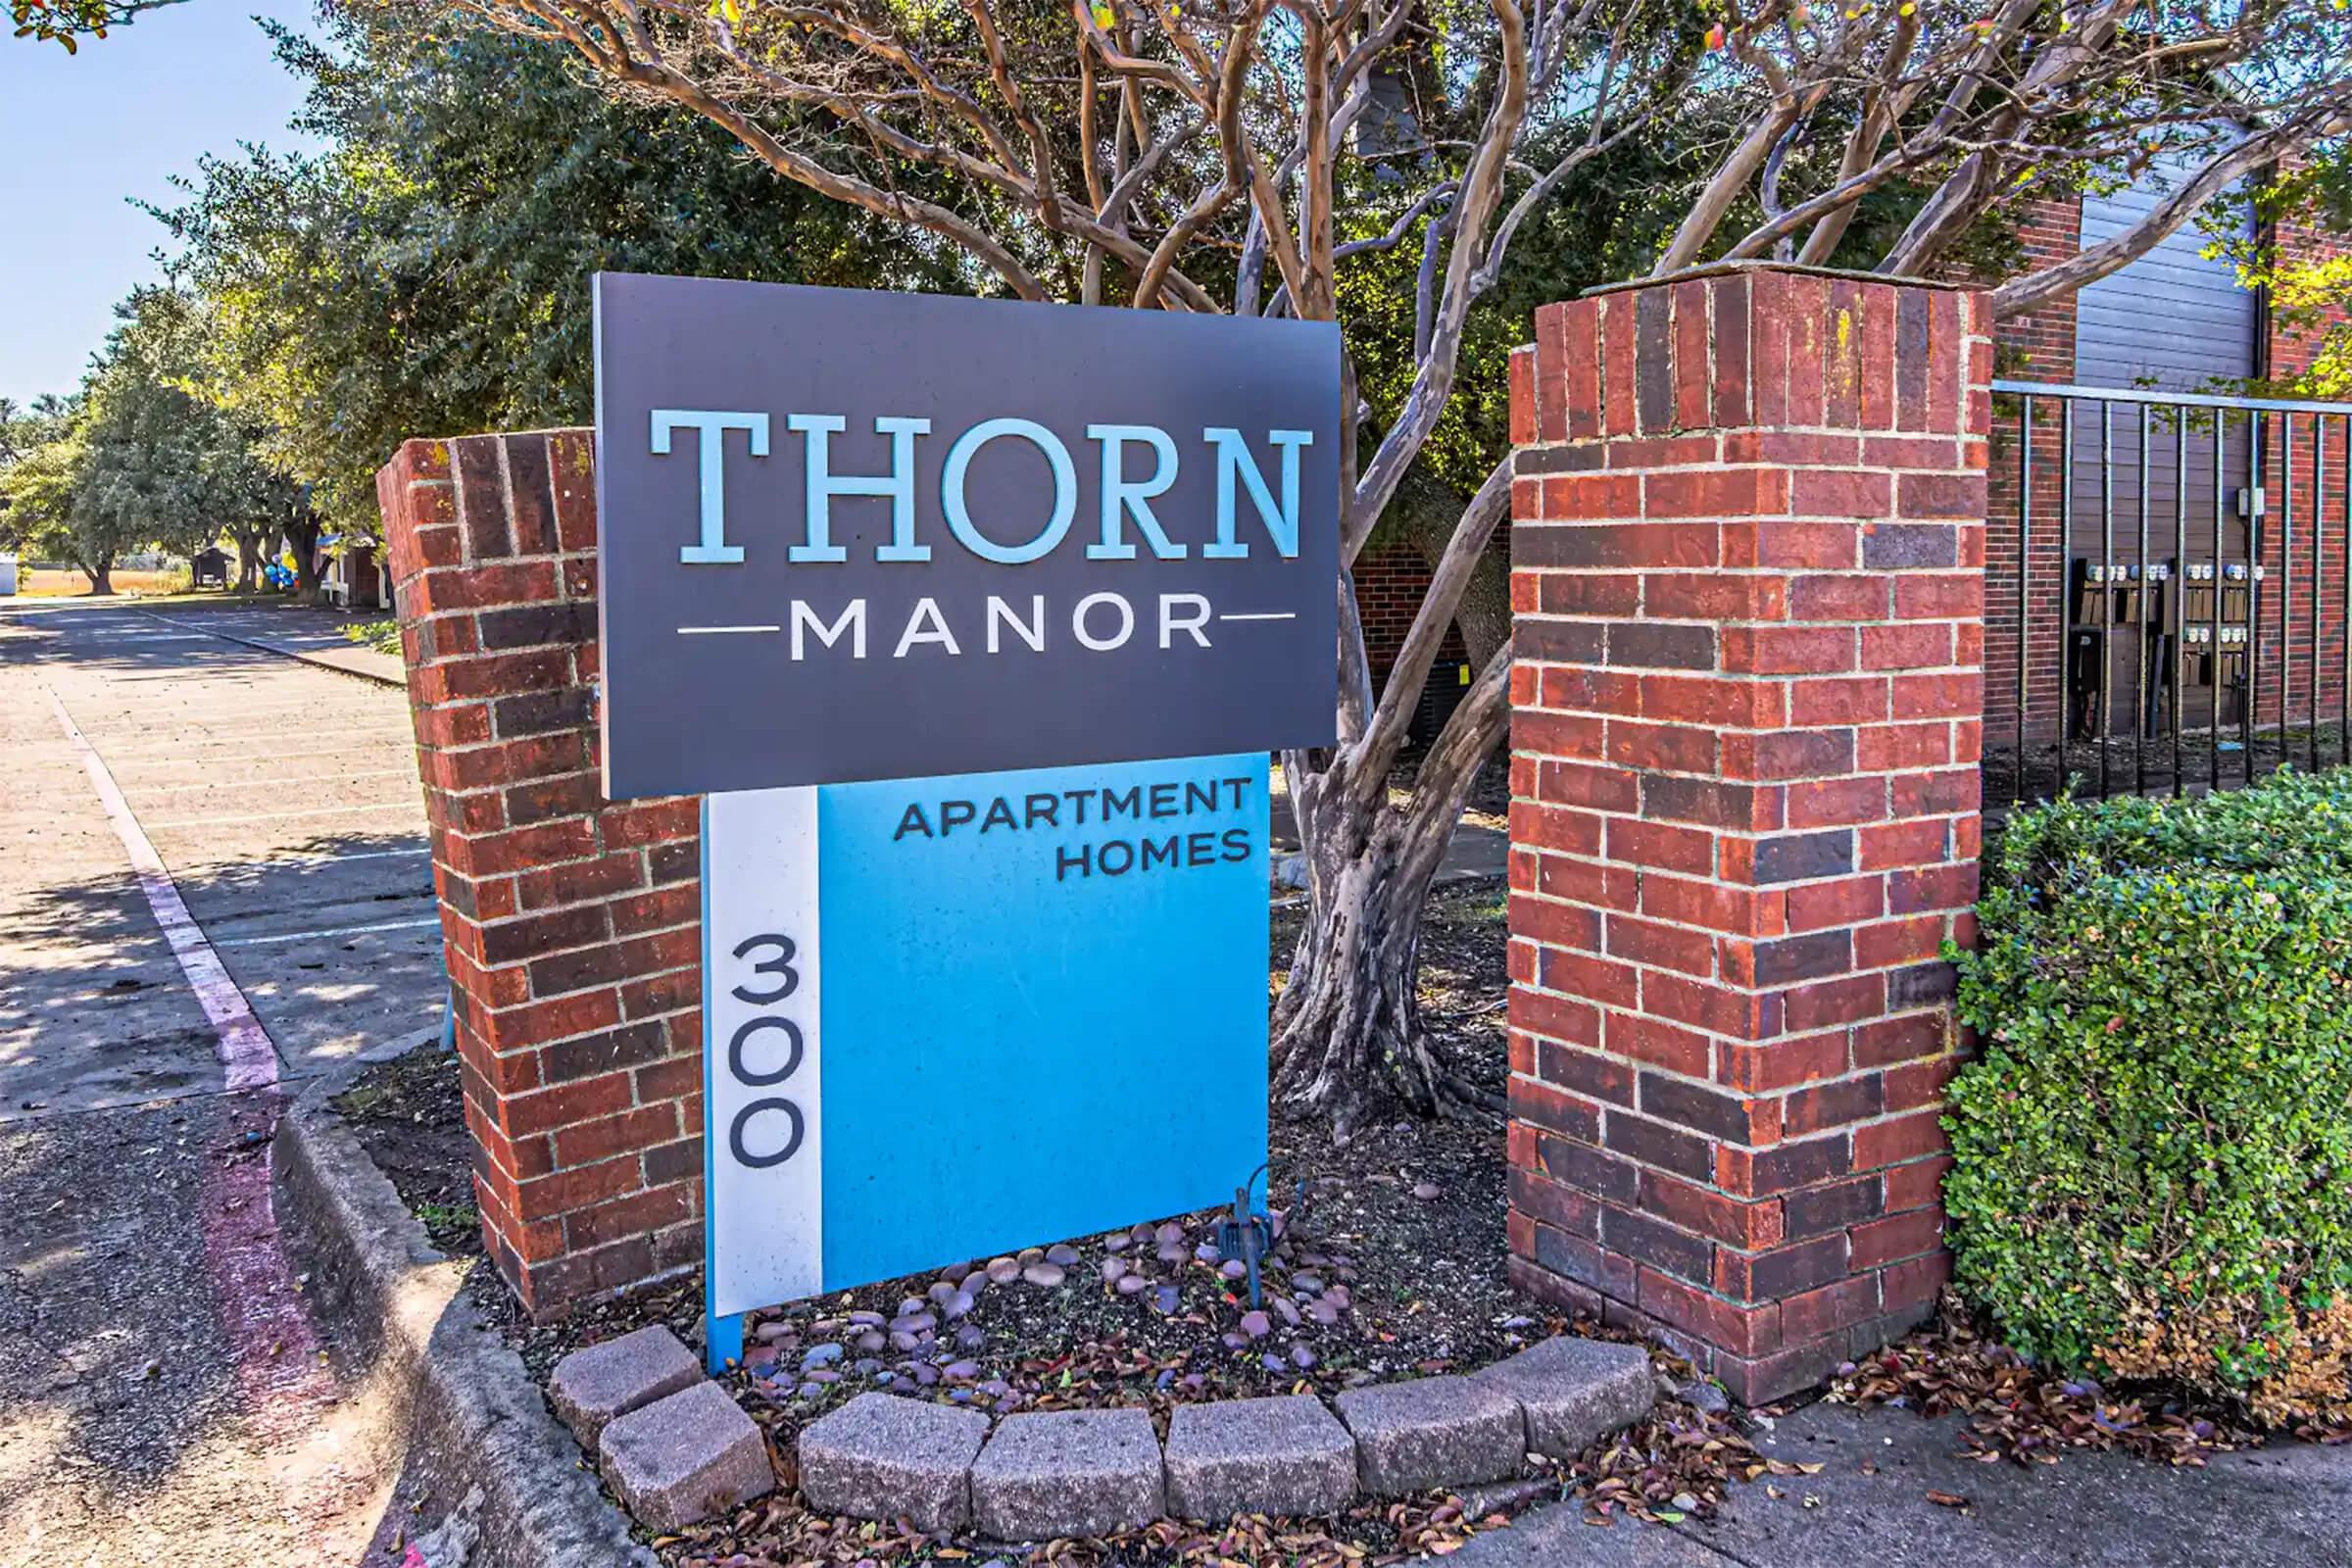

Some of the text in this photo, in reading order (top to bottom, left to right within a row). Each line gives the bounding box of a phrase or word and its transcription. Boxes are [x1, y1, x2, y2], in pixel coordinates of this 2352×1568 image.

[651, 409, 1313, 564] THORN
[790, 592, 1212, 661] MANOR
[893, 777, 1252, 842] APARTMENT
[1055, 828, 1252, 883] HOMES
[728, 933, 805, 1169] 300
